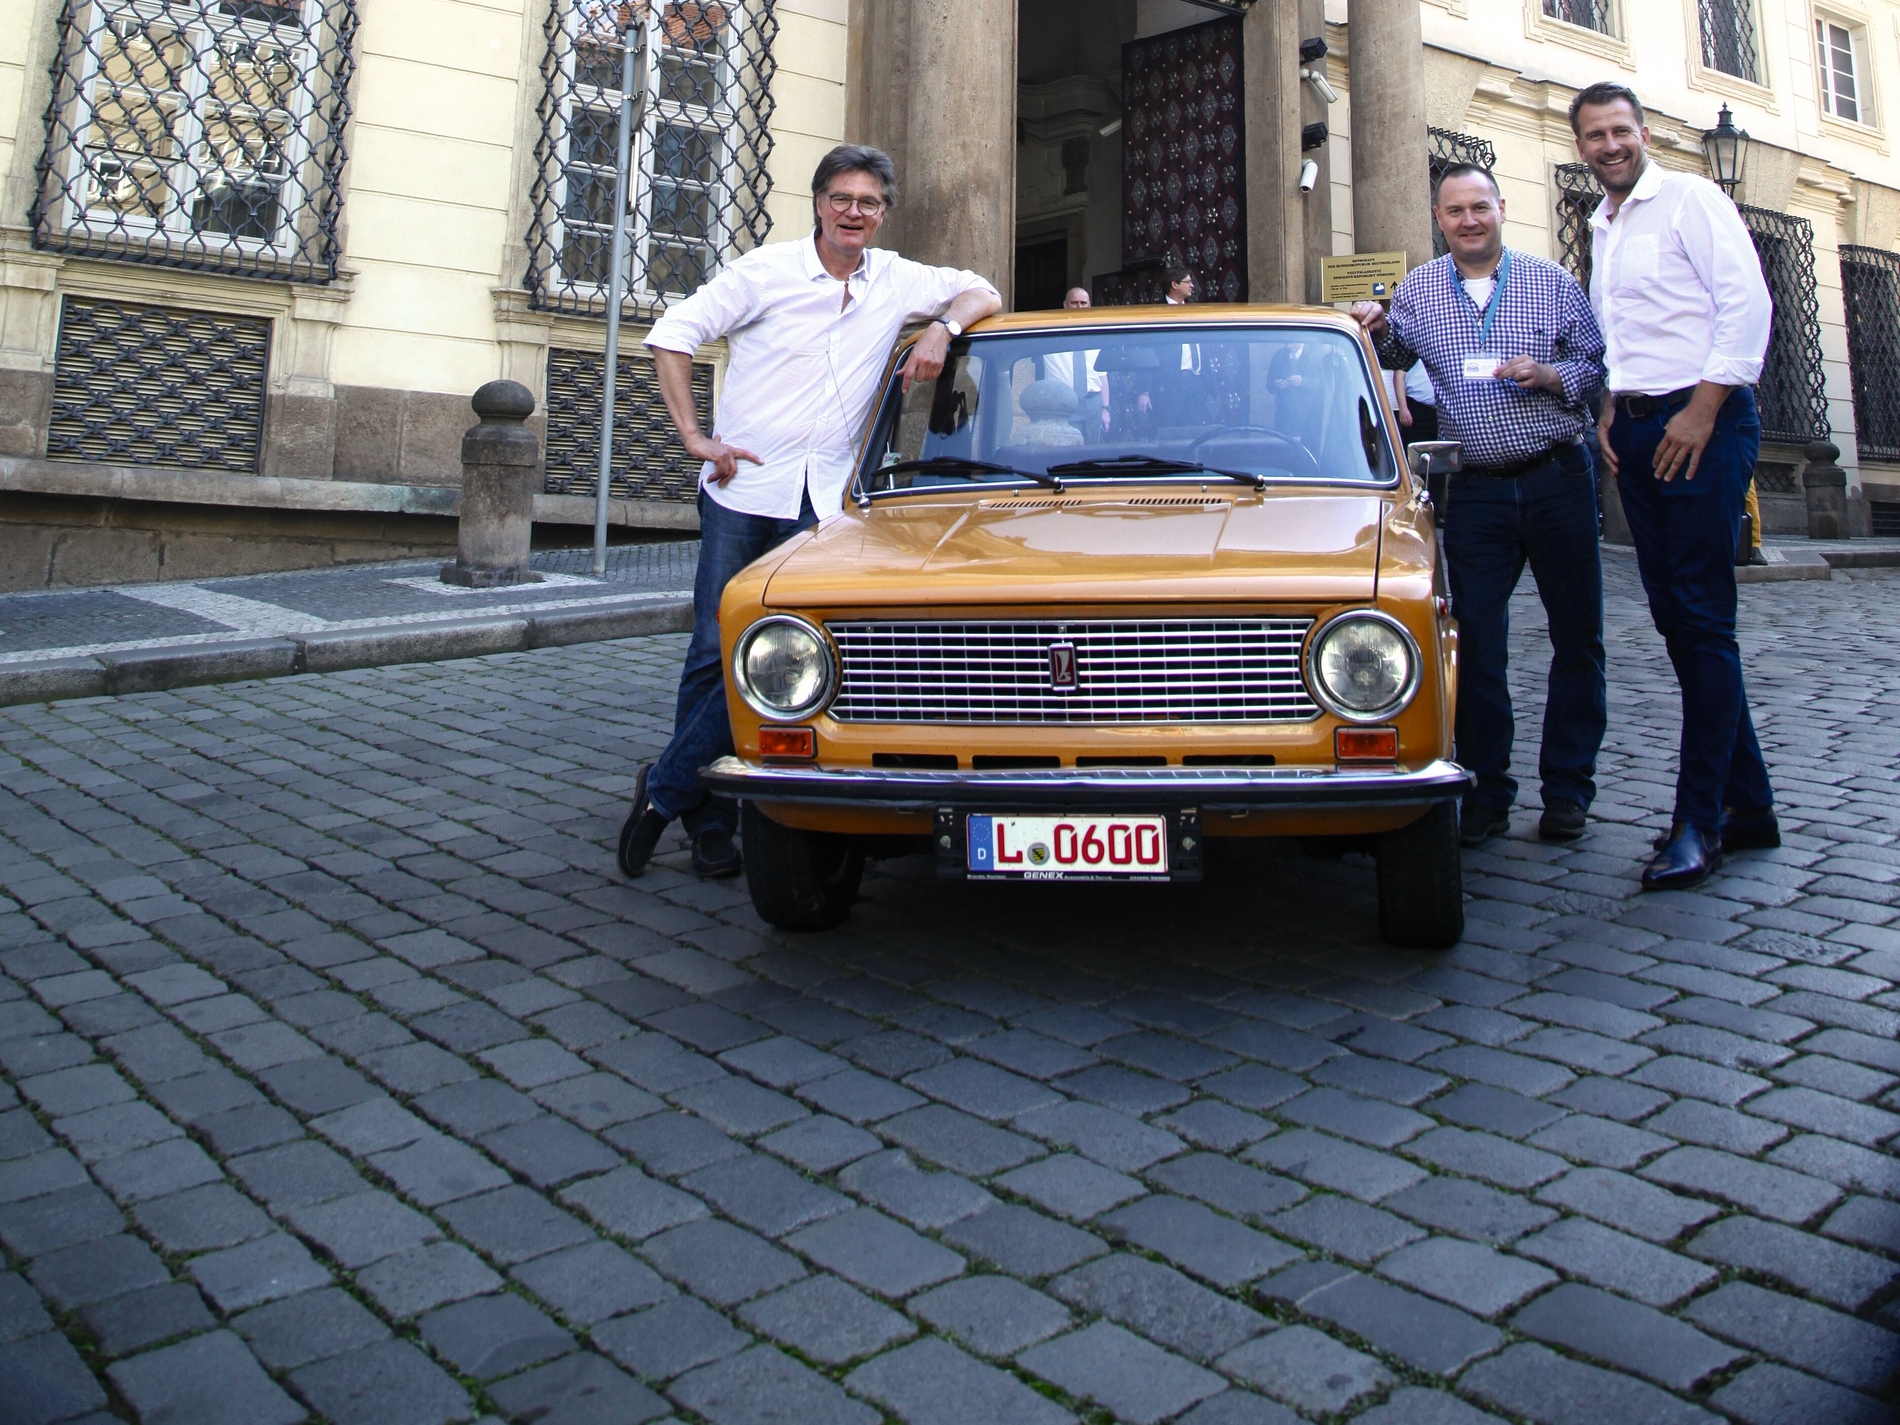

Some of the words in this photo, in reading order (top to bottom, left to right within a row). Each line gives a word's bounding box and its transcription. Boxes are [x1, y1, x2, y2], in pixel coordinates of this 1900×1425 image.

[997, 823, 1023, 863] L
[1054, 823, 1160, 865] 0600
[977, 847, 987, 860] D
[1024, 871, 1064, 880] GENEX
